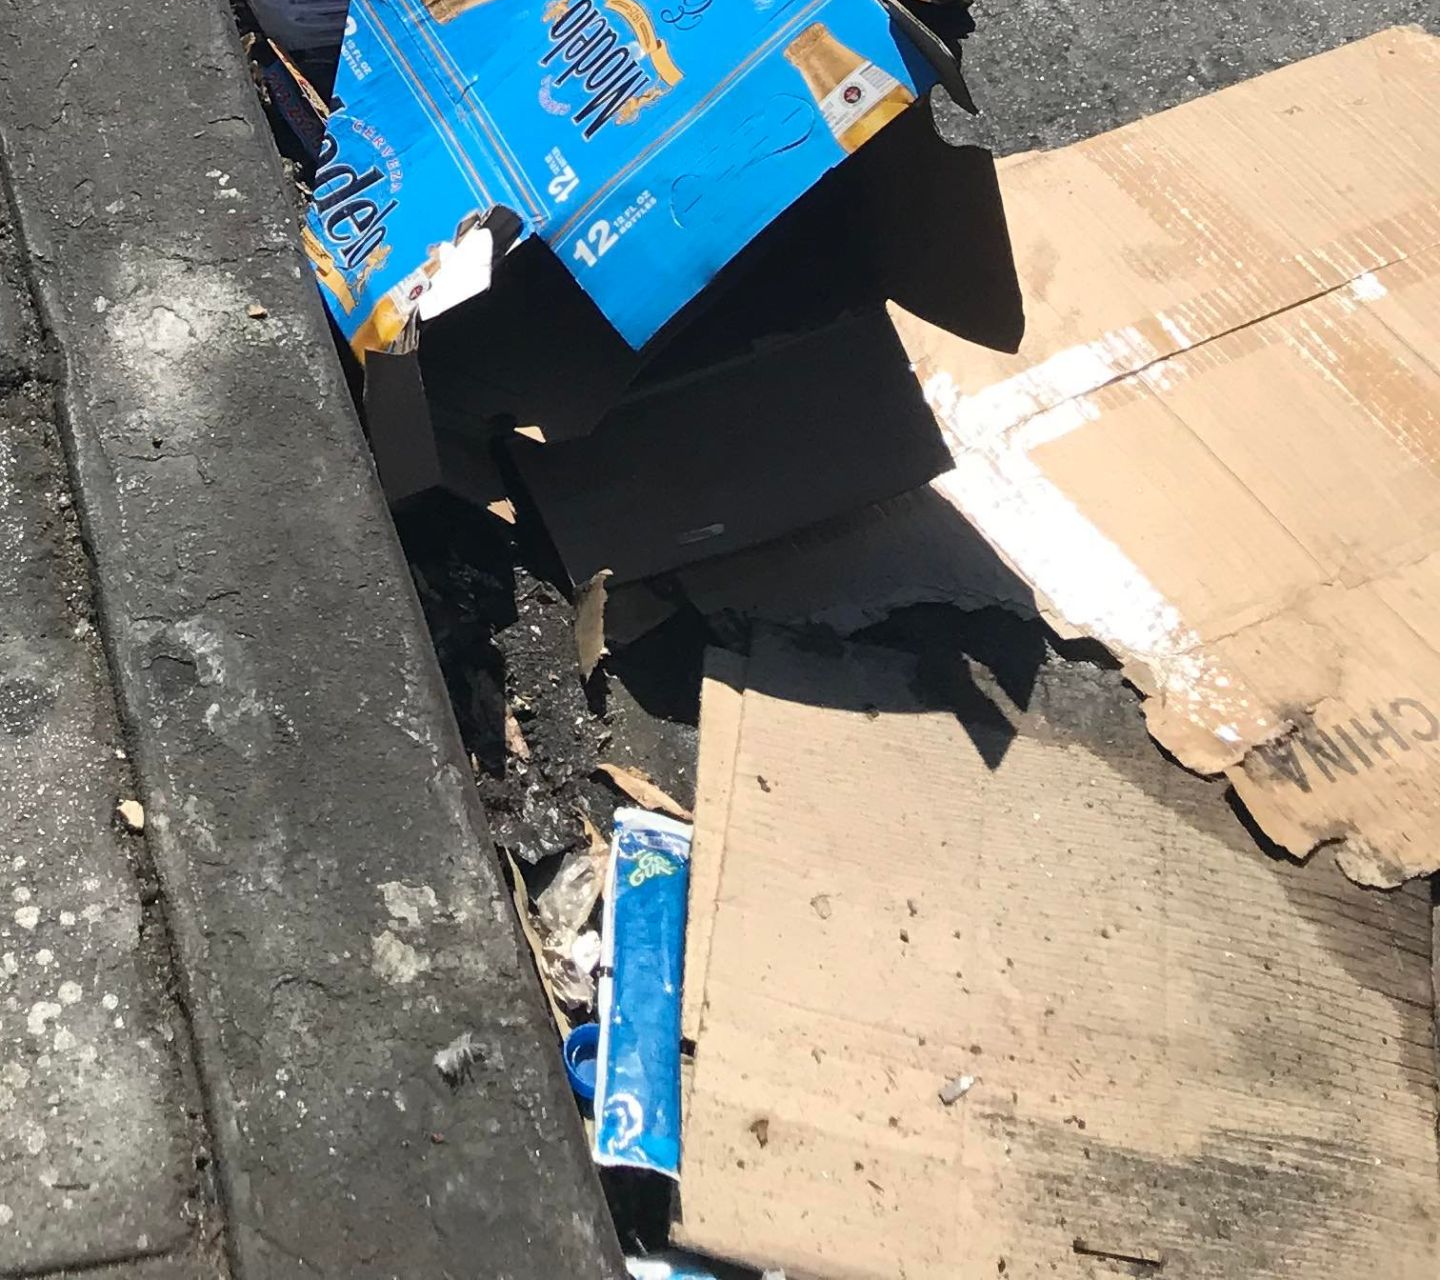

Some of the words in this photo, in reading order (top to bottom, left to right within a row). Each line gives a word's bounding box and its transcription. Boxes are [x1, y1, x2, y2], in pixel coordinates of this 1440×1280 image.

[352, 119, 404, 193] CERVEZA
[548, 165, 580, 204] 12
[572, 219, 620, 268] 12
[1260, 697, 1440, 793] CHINA
